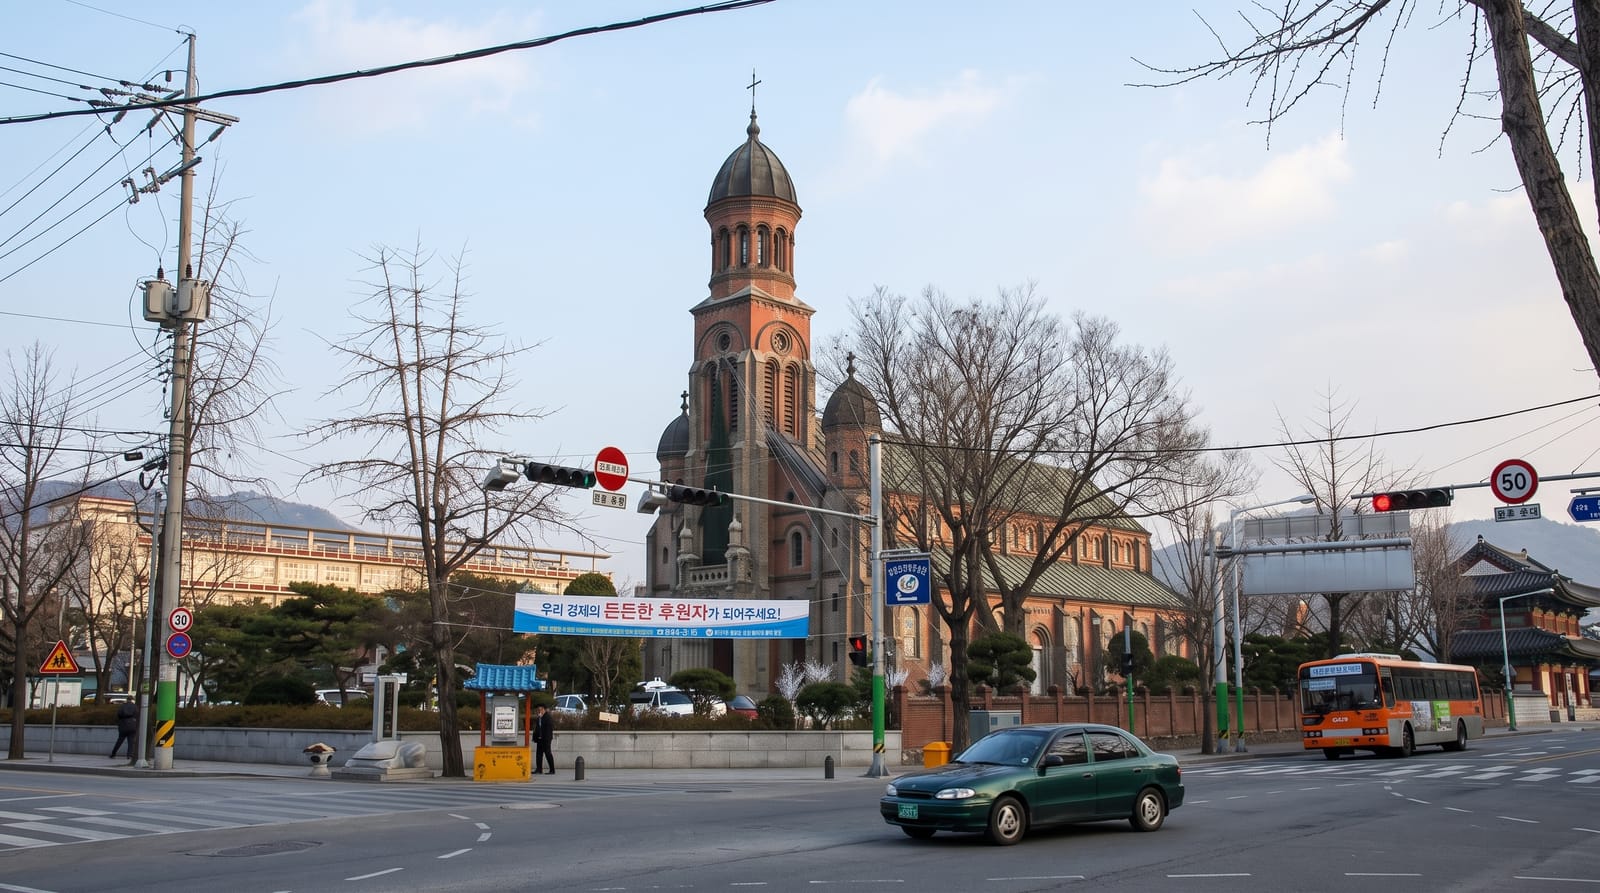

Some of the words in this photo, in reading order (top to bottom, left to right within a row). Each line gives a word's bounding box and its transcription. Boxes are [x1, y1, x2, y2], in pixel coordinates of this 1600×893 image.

[1502, 472, 1526, 492] 50
[174, 614, 187, 626] 30
[541, 602, 563, 617] 우리
[567, 603, 600, 618] 경제의
[604, 602, 654, 620] 든든한
[658, 603, 720, 621] 후원자가
[723, 607, 781, 621] 되어주세요!
